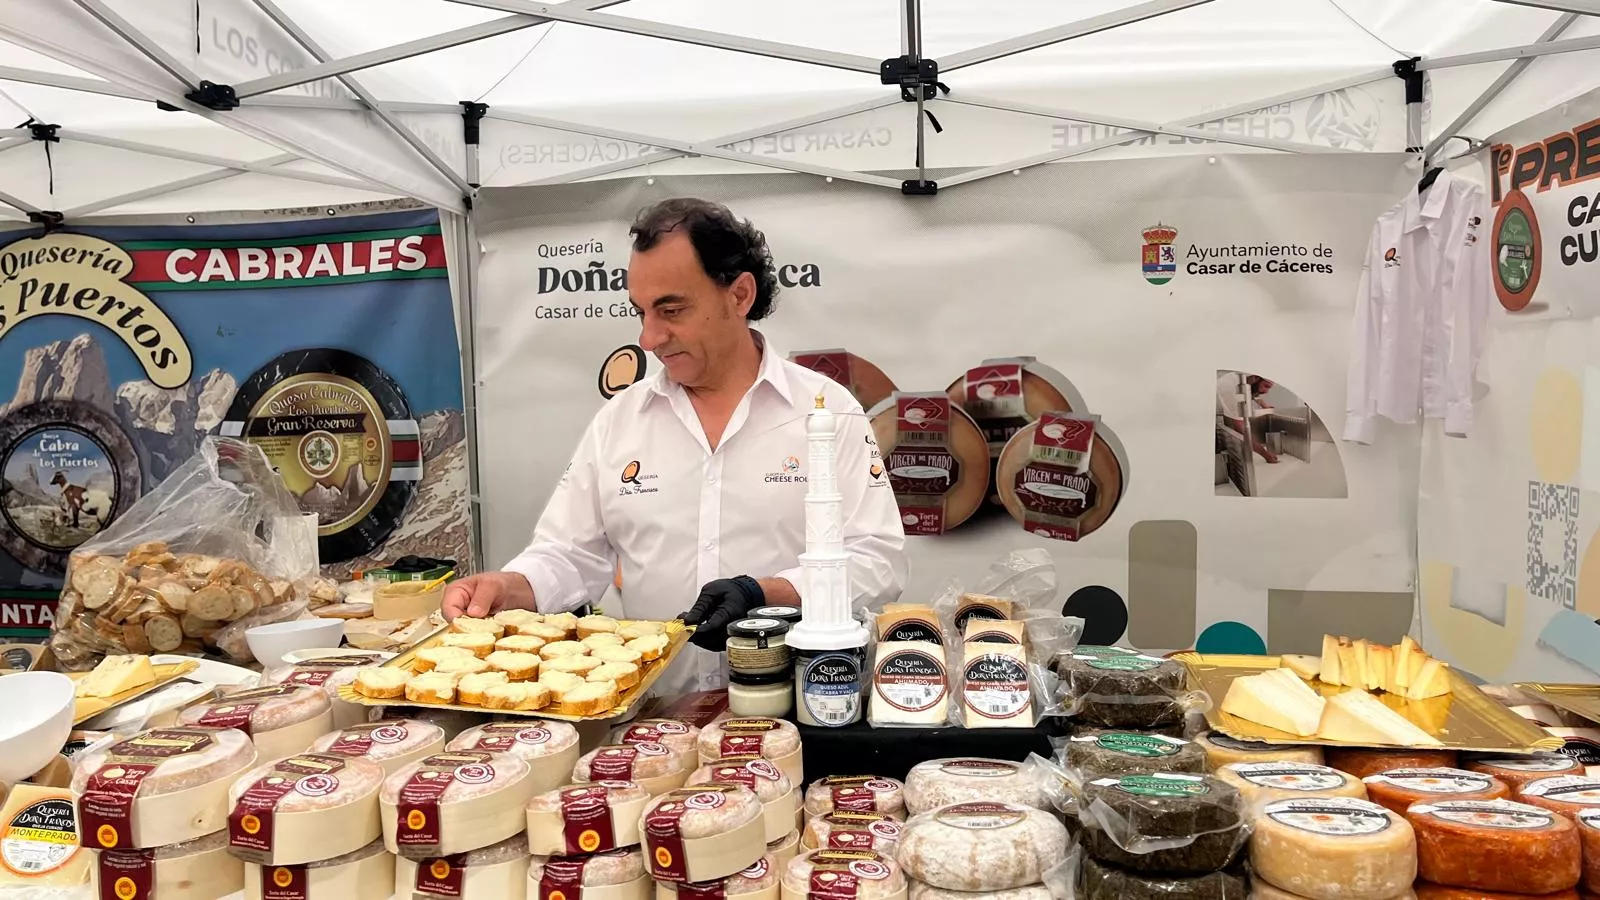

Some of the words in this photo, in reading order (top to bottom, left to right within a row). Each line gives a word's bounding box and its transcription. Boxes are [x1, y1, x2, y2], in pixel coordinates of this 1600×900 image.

[165, 236, 427, 282] CABRALES
[538, 239, 604, 259] Quesería
[1187, 242, 1308, 262] Ayuntamiento
[1312, 243, 1333, 258] de
[1, 246, 123, 284] Quesería
[1186, 262, 1235, 275] Casar
[1239, 260, 1261, 274] de
[1266, 259, 1333, 274] Cáceres
[537, 261, 628, 294] Doña
[535, 306, 579, 319] Casar
[584, 304, 603, 318] de
[15, 278, 178, 369] Puertos
[269, 391, 307, 415] Queso
[309, 386, 362, 411] Cabrales
[288, 405, 308, 416] Los
[311, 404, 349, 416] Puertos
[267, 418, 301, 436] Gran
[301, 416, 357, 430] Reserva
[40, 439, 79, 452] Cabra
[889, 454, 916, 469] VIRGEN
[927, 455, 952, 471] PRADO
[1023, 468, 1051, 483] VIRGEN
[1063, 474, 1090, 493] PRADO
[10, 828, 77, 841] MONTEPRADO
